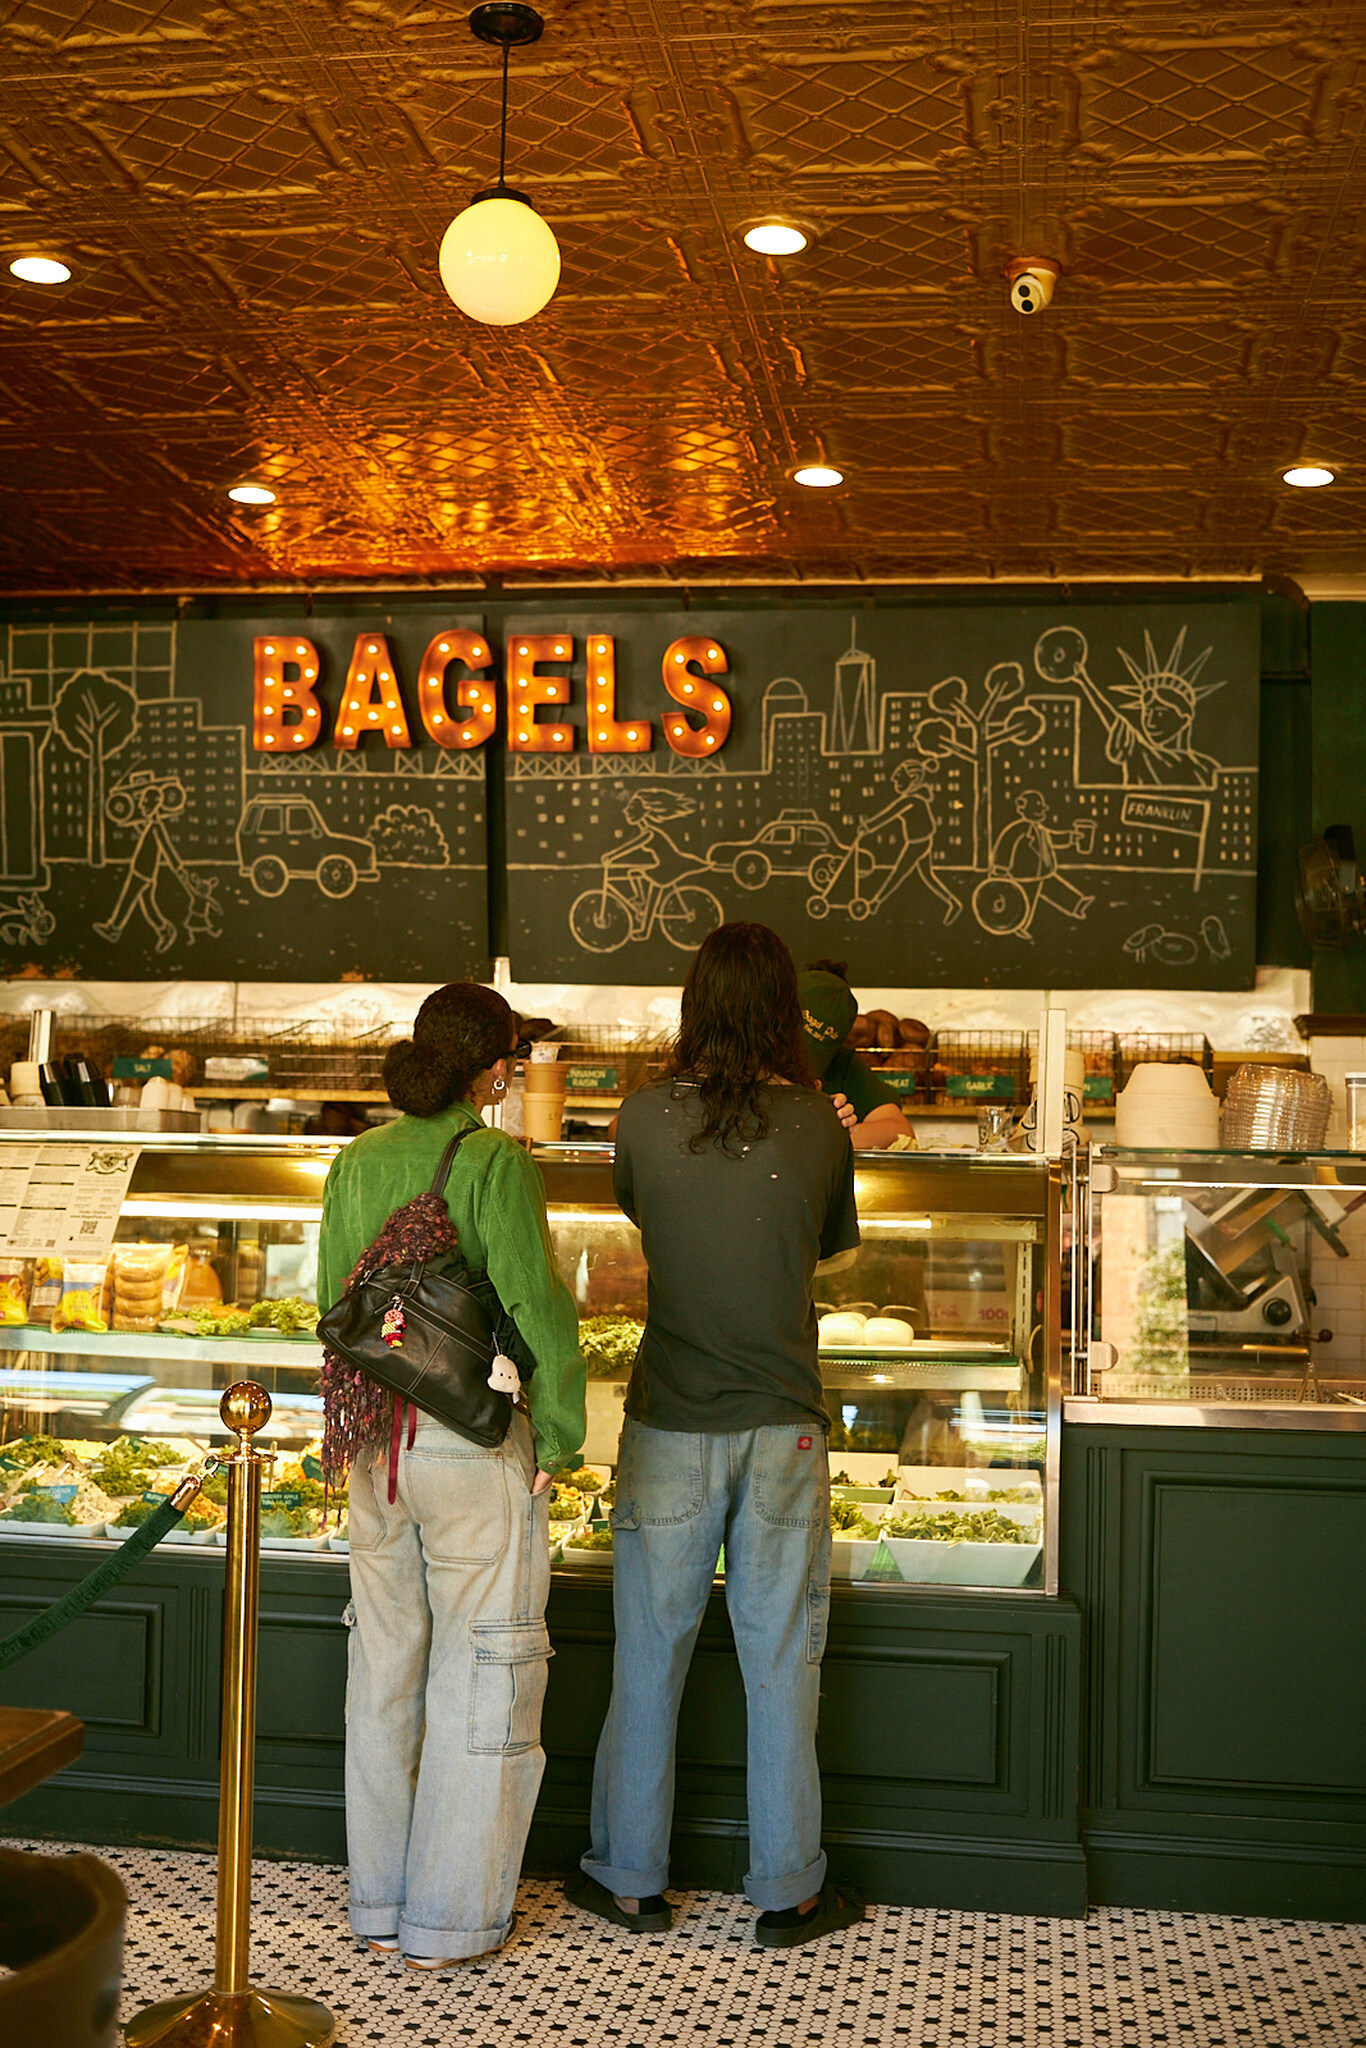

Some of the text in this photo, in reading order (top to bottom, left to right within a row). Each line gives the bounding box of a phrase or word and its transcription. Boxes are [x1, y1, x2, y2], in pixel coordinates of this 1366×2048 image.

[253, 629, 732, 758] BAGELS
[1127, 802, 1192, 821] FRANKLIN
[572, 1079, 598, 1088] RAISIN
[965, 1080, 995, 1091] GARLIC
